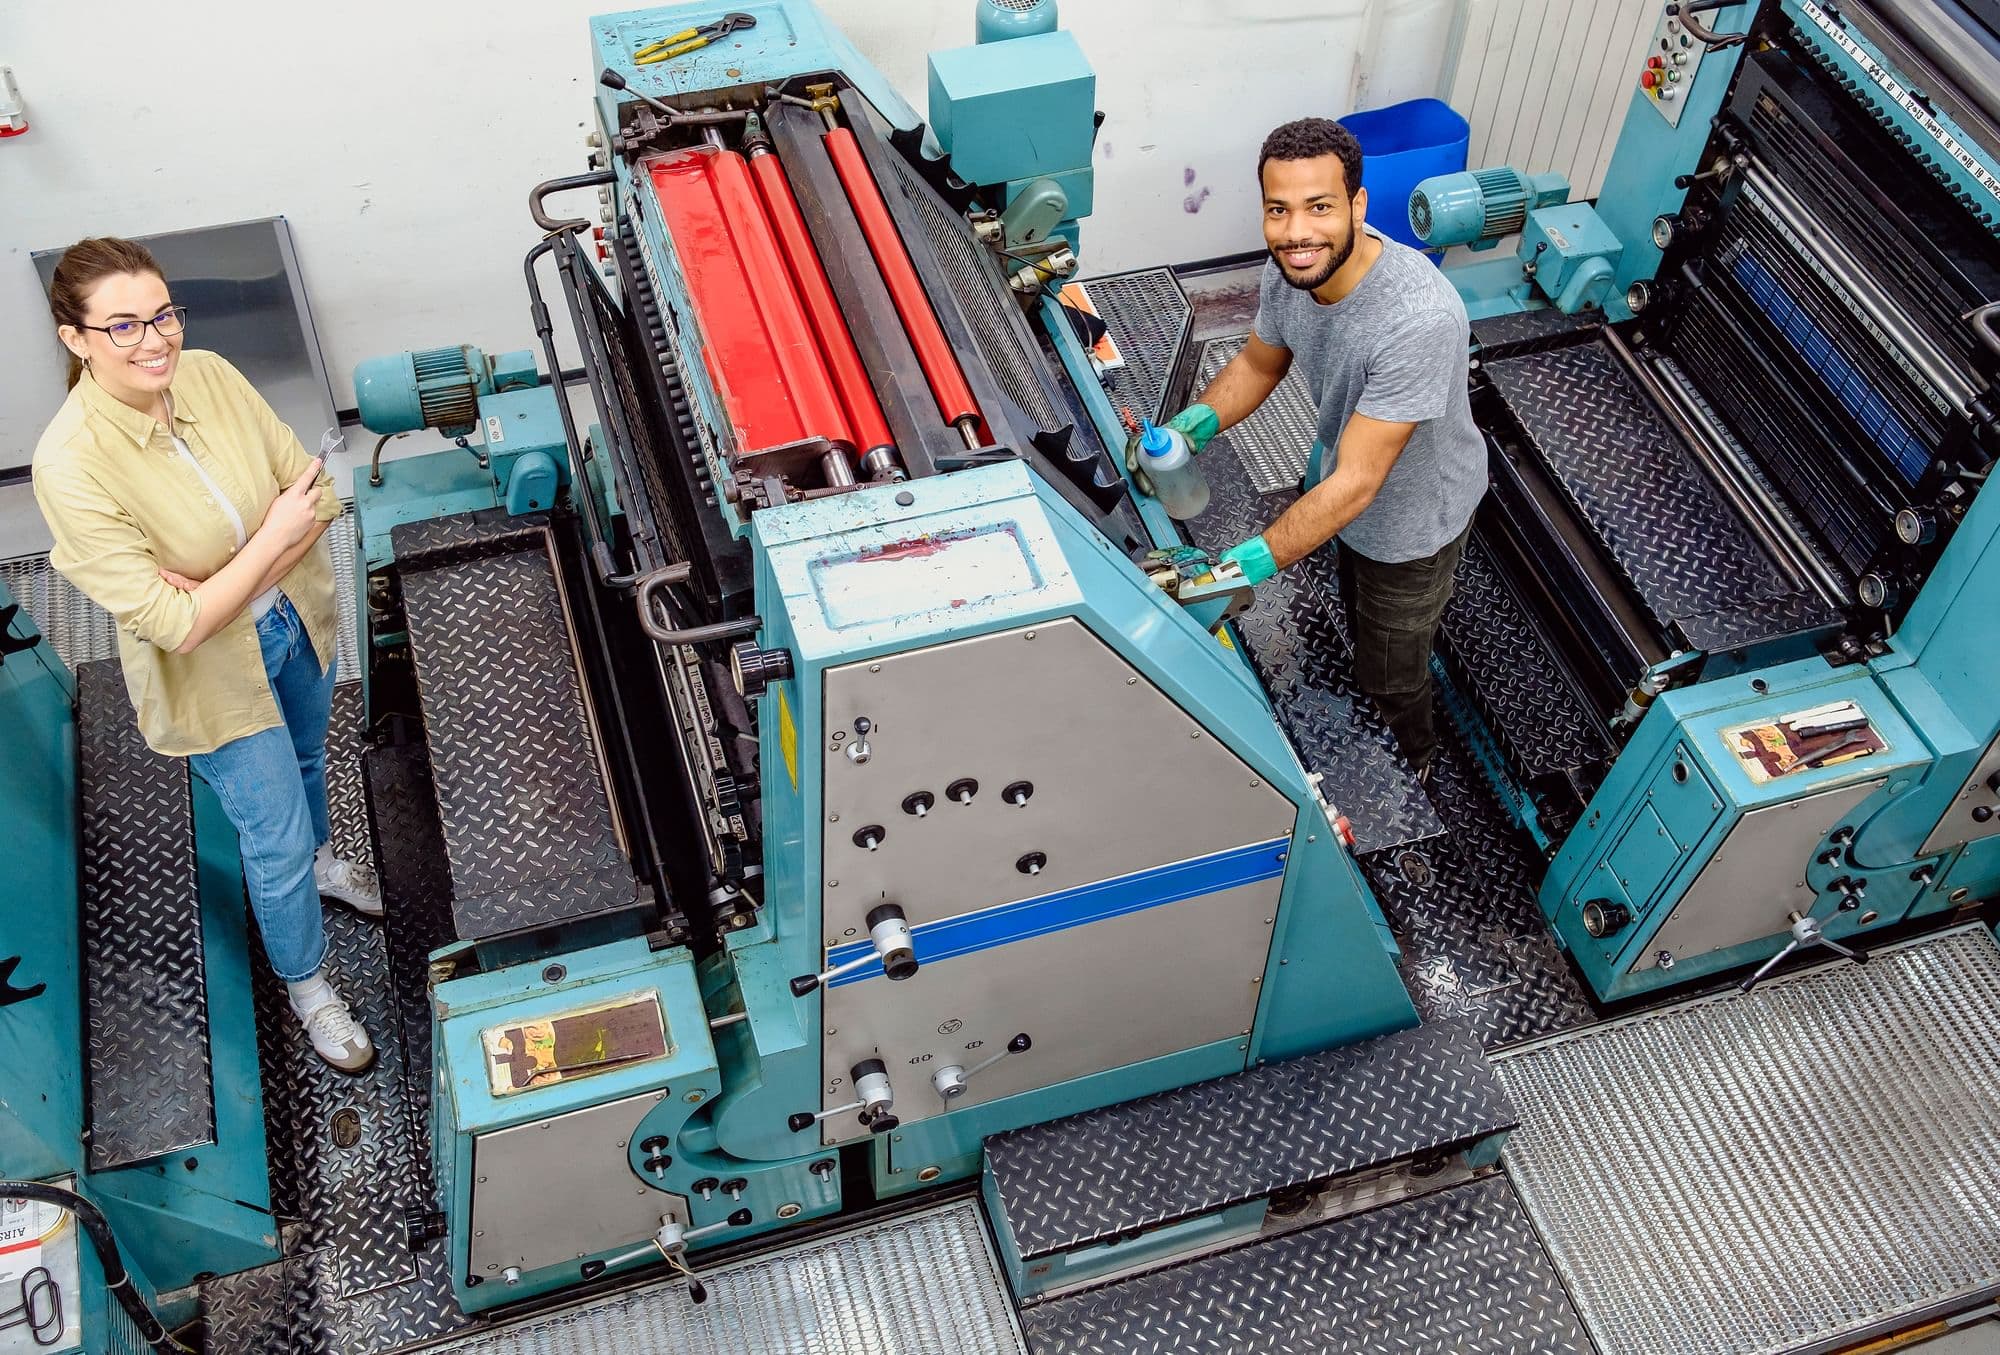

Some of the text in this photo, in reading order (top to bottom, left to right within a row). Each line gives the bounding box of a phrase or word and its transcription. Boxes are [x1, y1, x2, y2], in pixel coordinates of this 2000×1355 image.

[1878, 74, 1884, 82] 9
[1886, 81, 1894, 91] 10
[1896, 91, 1904, 101] 11
[1905, 100, 1914, 110] 12
[1915, 110, 1924, 119] 13
[1925, 119, 1932, 129] 14
[1934, 128, 1943, 138] 15
[1944, 137, 1953, 148] 16
[1954, 148, 1963, 157] 17
[1965, 158, 1974, 168] 18
[1974, 167, 1984, 178] 19
[1984, 178, 1994, 188] 20
